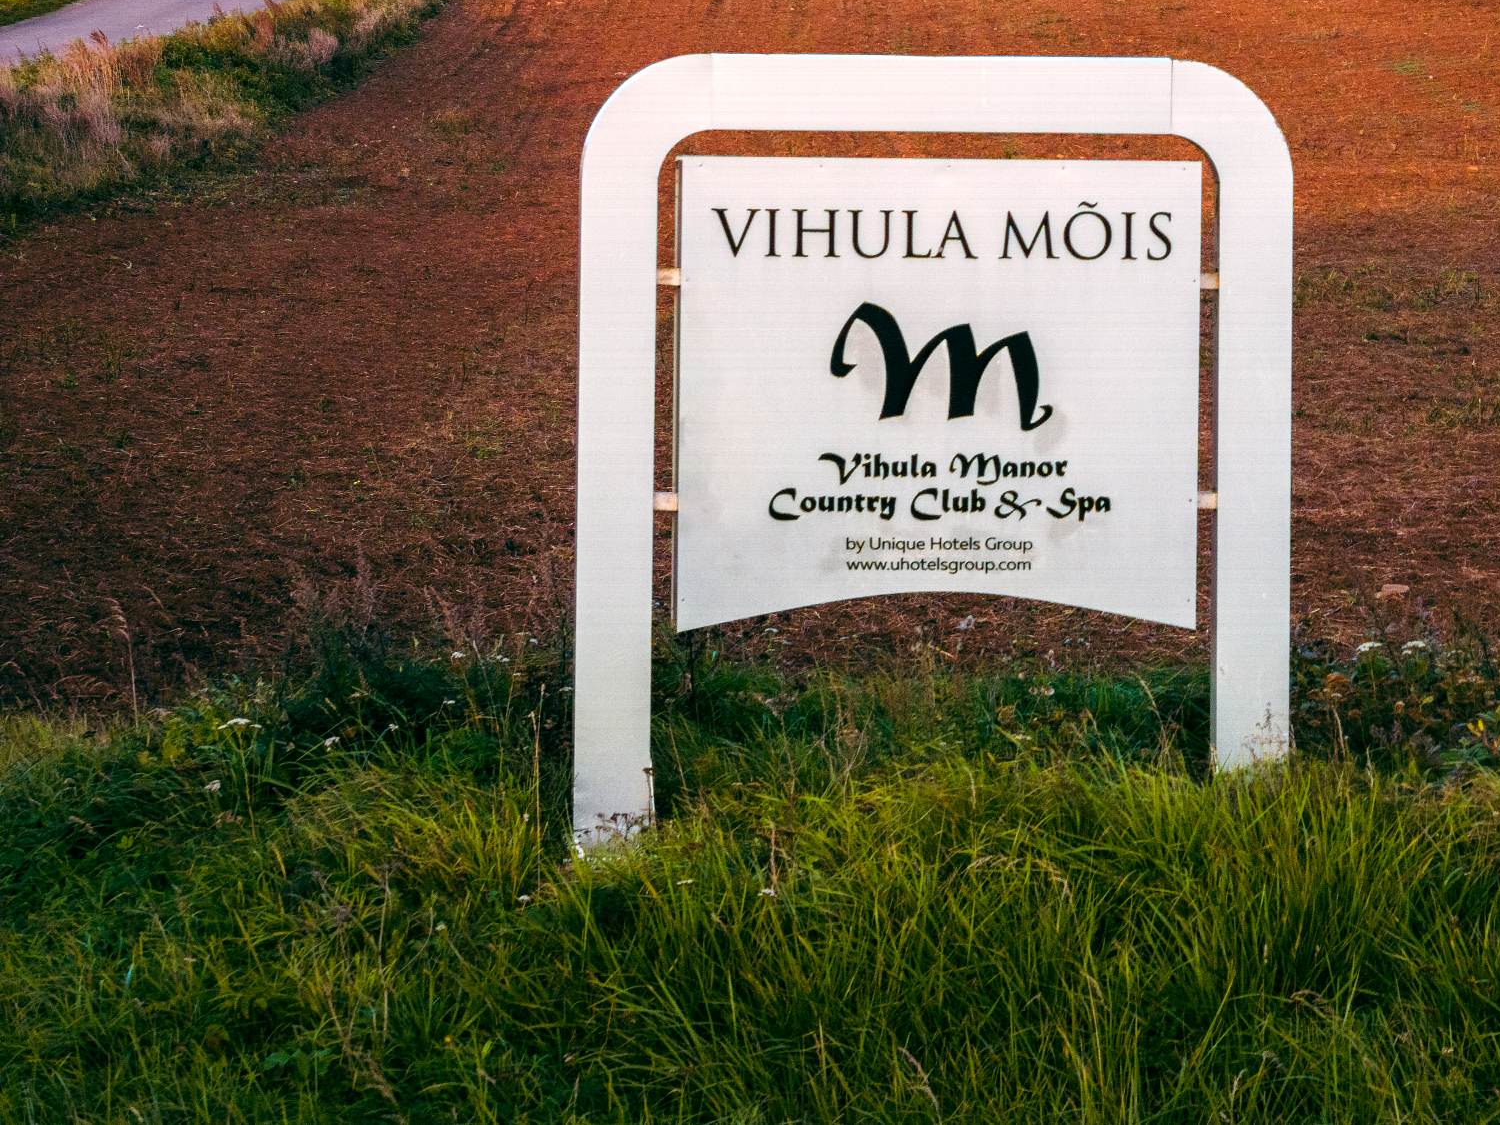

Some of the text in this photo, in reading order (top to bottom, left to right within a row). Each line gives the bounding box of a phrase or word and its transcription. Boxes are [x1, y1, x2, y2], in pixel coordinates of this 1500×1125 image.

[710, 200, 1174, 261] VIHULA MÕIS
[818, 451, 1069, 486] Vihula Manor
[767, 486, 1112, 523] Country Club & Spa
[845, 536, 1034, 554] by Unique Hotels Group
[845, 556, 1033, 575] www.uhotelsgroup.com
